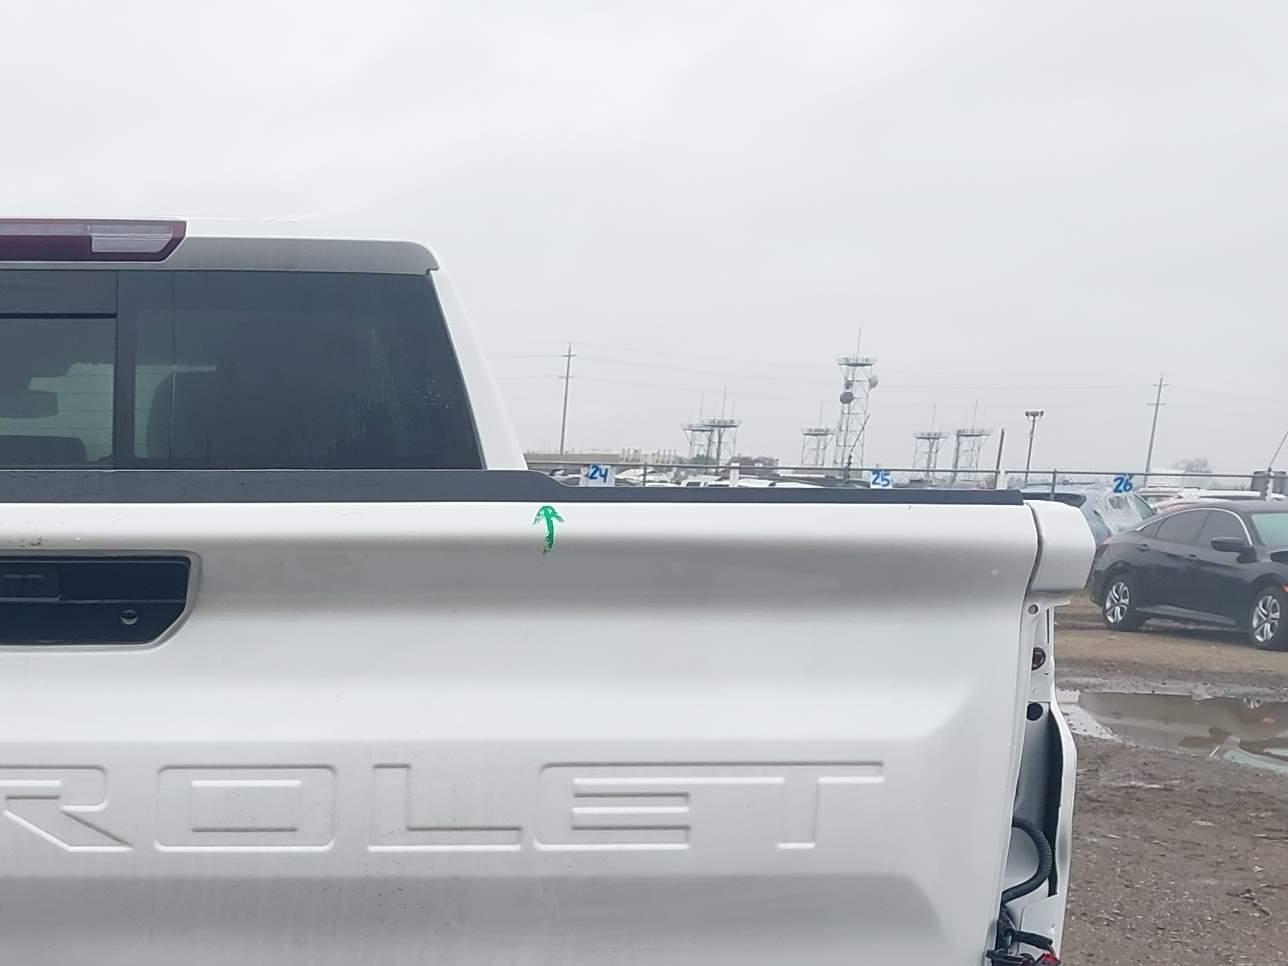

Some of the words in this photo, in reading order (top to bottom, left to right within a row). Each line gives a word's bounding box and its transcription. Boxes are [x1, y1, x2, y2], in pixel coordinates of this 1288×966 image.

[587, 465, 609, 483] 24
[872, 469, 890, 487] 25
[1113, 474, 1133, 493] 26
